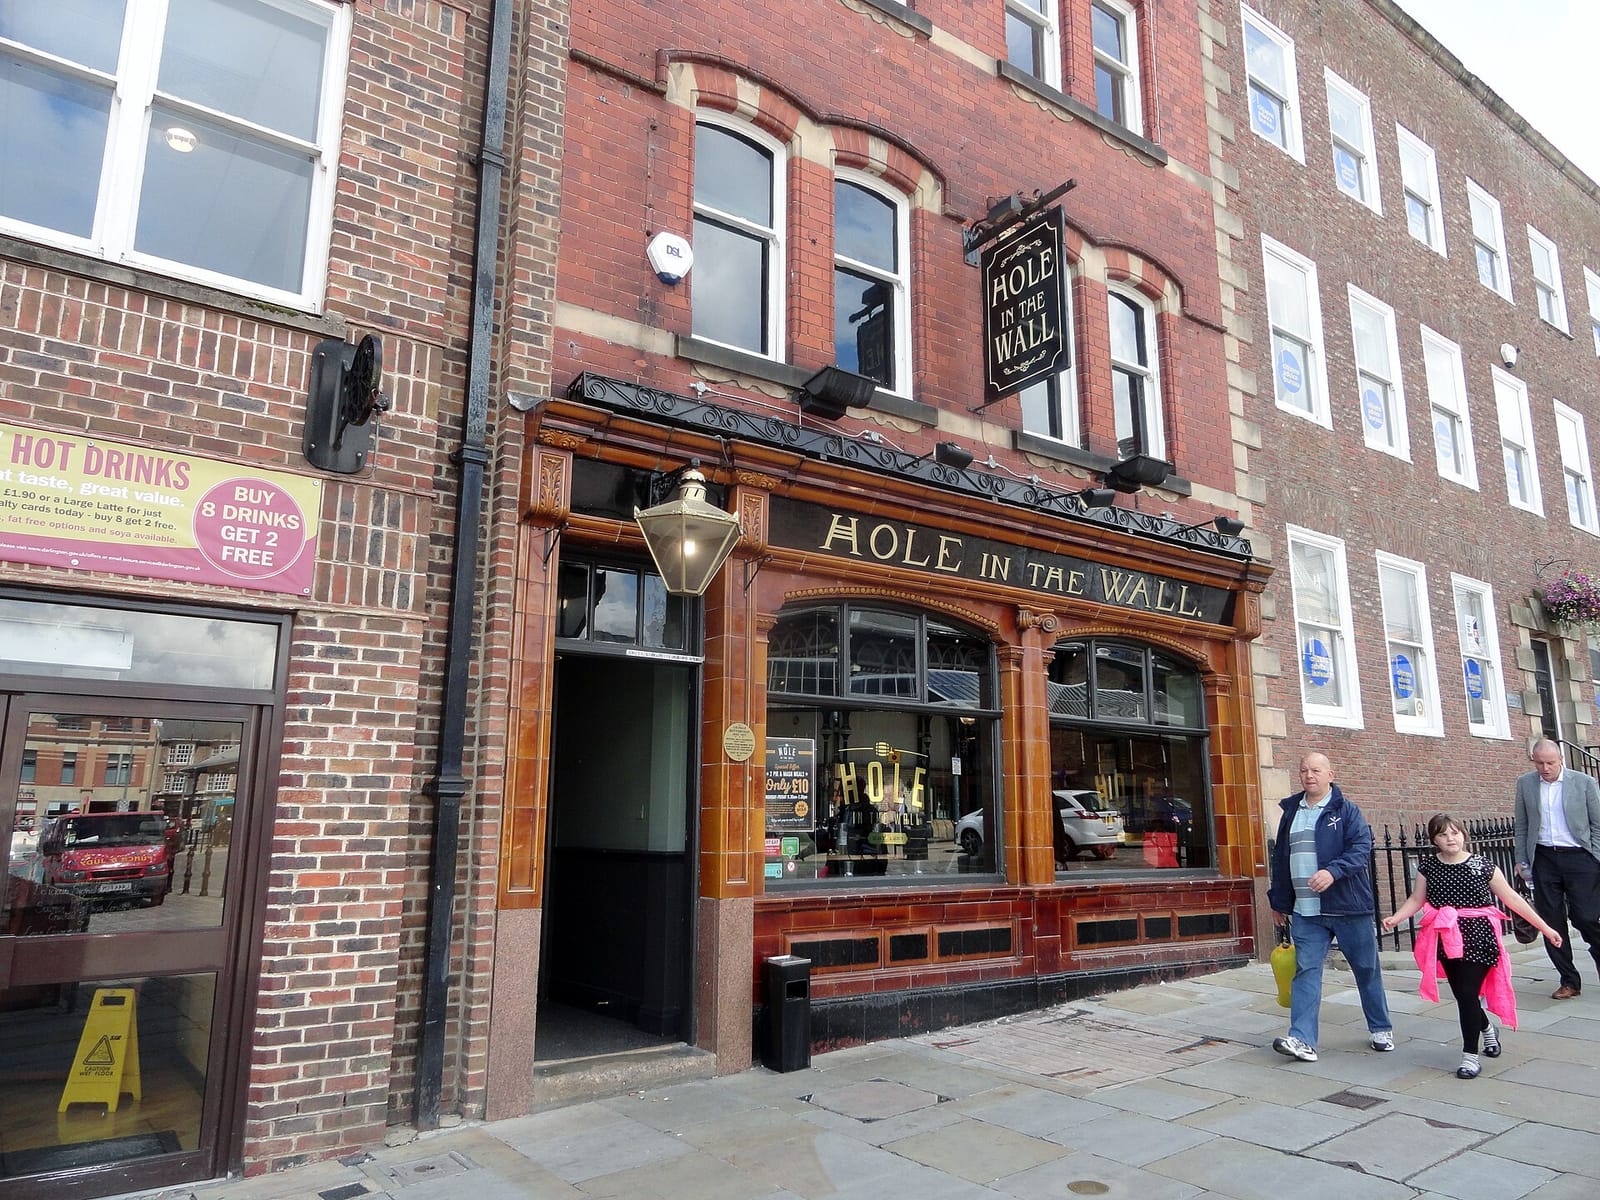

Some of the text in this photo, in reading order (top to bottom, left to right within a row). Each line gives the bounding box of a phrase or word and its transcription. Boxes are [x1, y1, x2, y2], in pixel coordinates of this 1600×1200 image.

[991, 247, 1054, 308] HOLE
[1001, 290, 1046, 329] IN THE
[994, 312, 1055, 365] WALL
[11, 433, 191, 490] HOT DRINKS
[3, 488, 36, 500] £1.90
[39, 494, 51, 502] or
[63, 496, 94, 508] Large
[97, 501, 124, 512] Latte
[126, 505, 141, 515] for
[143, 508, 162, 518] just
[18, 470, 73, 492] taste,
[80, 481, 129, 499] great
[135, 491, 184, 507] value.
[234, 486, 276, 506] BUY
[8, 515, 22, 523] fat
[25, 517, 46, 526] free
[49, 521, 86, 532] options
[88, 526, 107, 534] and
[109, 529, 132, 539] soya
[134, 532, 177, 544] available.
[21, 503, 51, 513] cards
[54, 507, 85, 519] today
[94, 512, 113, 523] buy
[115, 515, 123, 523] 8
[125, 517, 142, 526] get
[144, 519, 152, 527] 2
[154, 520, 177, 531] free.
[201, 501, 300, 530] 8 DRINKS
[220, 525, 278, 548] GET 2
[221, 545, 275, 567] FREE
[818, 513, 963, 573] HOLE
[979, 552, 1012, 582] IN
[1027, 561, 1086, 596] THE
[766, 777, 809, 794] Only £10
[839, 761, 927, 809] HOLE
